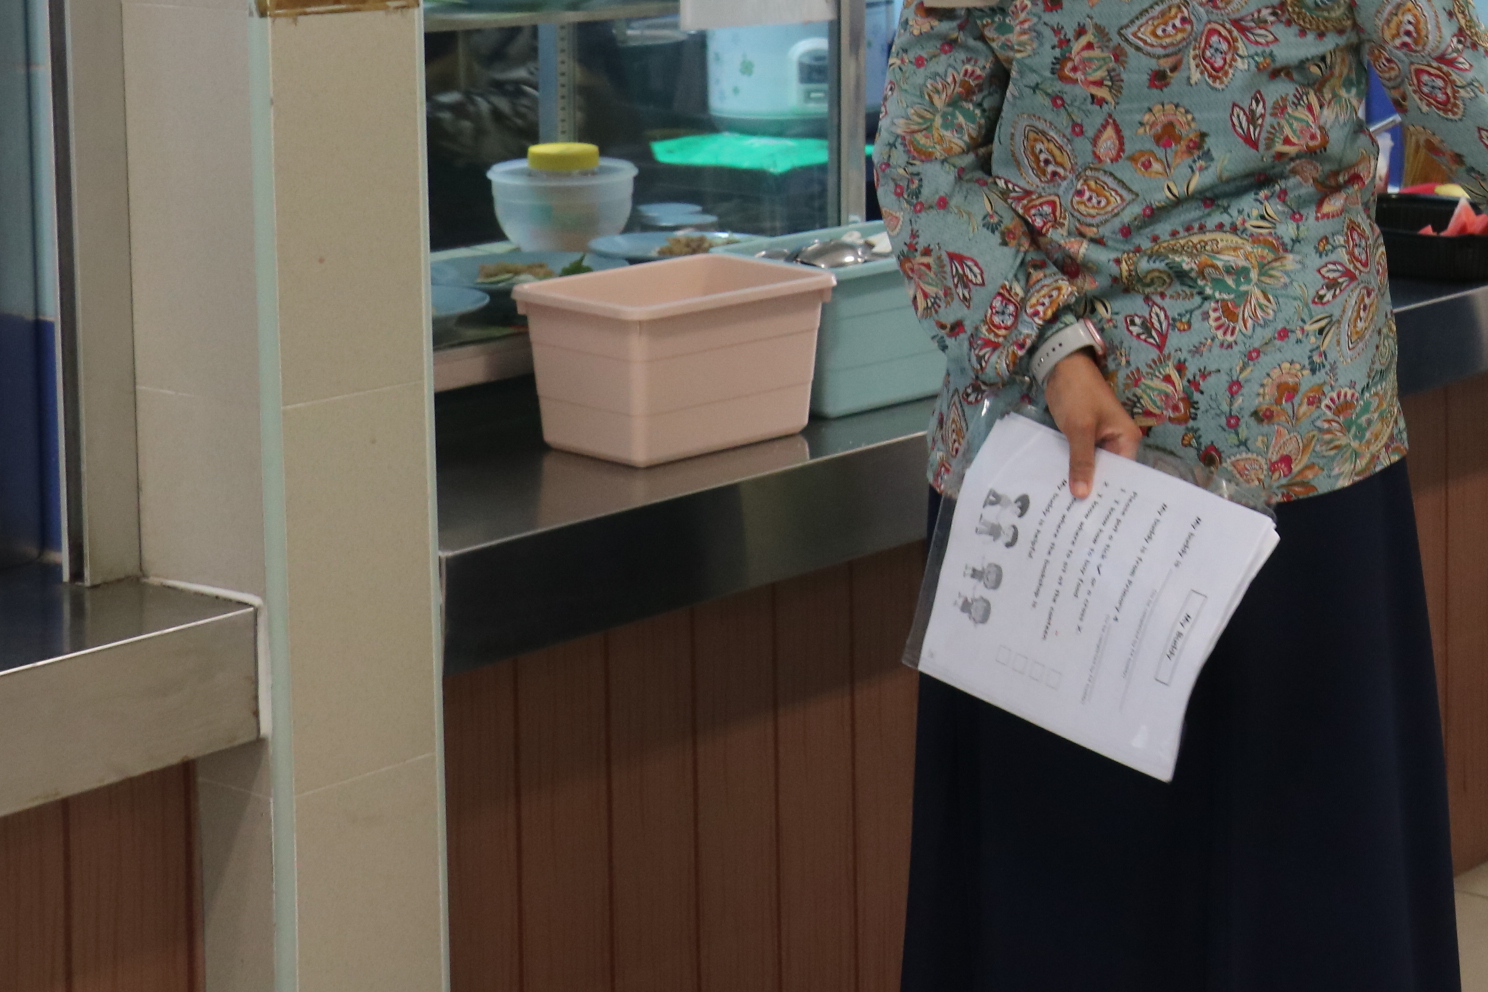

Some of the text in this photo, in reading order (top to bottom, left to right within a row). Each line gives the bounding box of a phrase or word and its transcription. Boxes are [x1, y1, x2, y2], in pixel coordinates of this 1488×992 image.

[1143, 518, 1160, 544] buddy
[1177, 531, 1195, 558] buddy
[1165, 630, 1183, 660] Buddy
